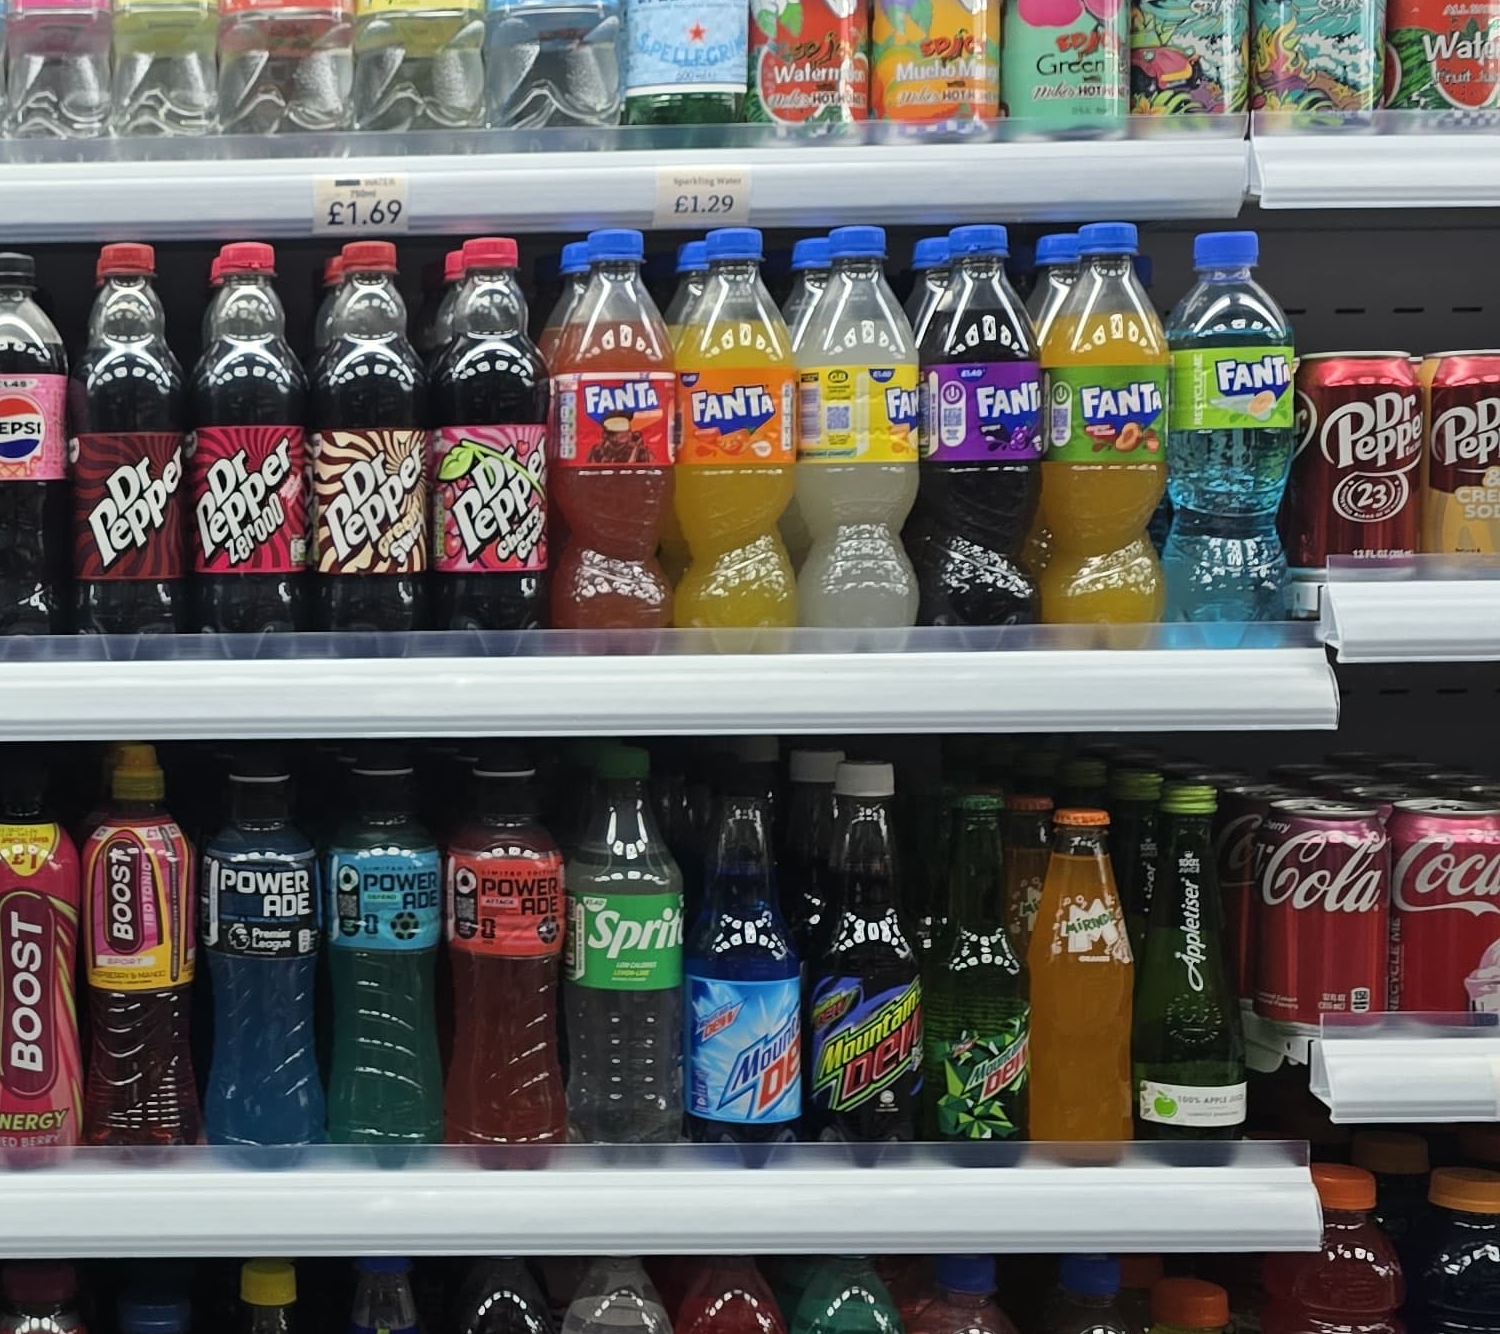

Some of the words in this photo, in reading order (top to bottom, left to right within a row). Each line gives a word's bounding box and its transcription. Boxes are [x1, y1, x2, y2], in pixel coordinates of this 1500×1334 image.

[328, 201, 403, 226] £1.69
[674, 195, 734, 214] £1.29
[584, 384, 659, 415] FANTA
[691, 387, 776, 426] FANTA
[107, 456, 152, 505] Dr
[207, 448, 252, 501] Dr
[88, 446, 183, 568] Pepper
[197, 437, 292, 561] Pepper
[324, 446, 424, 563] Pepper
[1357, 482, 1389, 507] 23
[220, 868, 310, 894] POWER
[364, 869, 438, 893] POWER
[1262, 829, 1386, 915] Cola
[402, 889, 440, 910] ADE
[480, 876, 559, 898] POWER
[262, 893, 311, 918] ADE
[520, 895, 559, 916] ADE
[251, 926, 292, 941] Premier
[251, 937, 292, 951] League
[10, 911, 44, 1073] BOOST
[19, 1132, 60, 1148] BERRY
